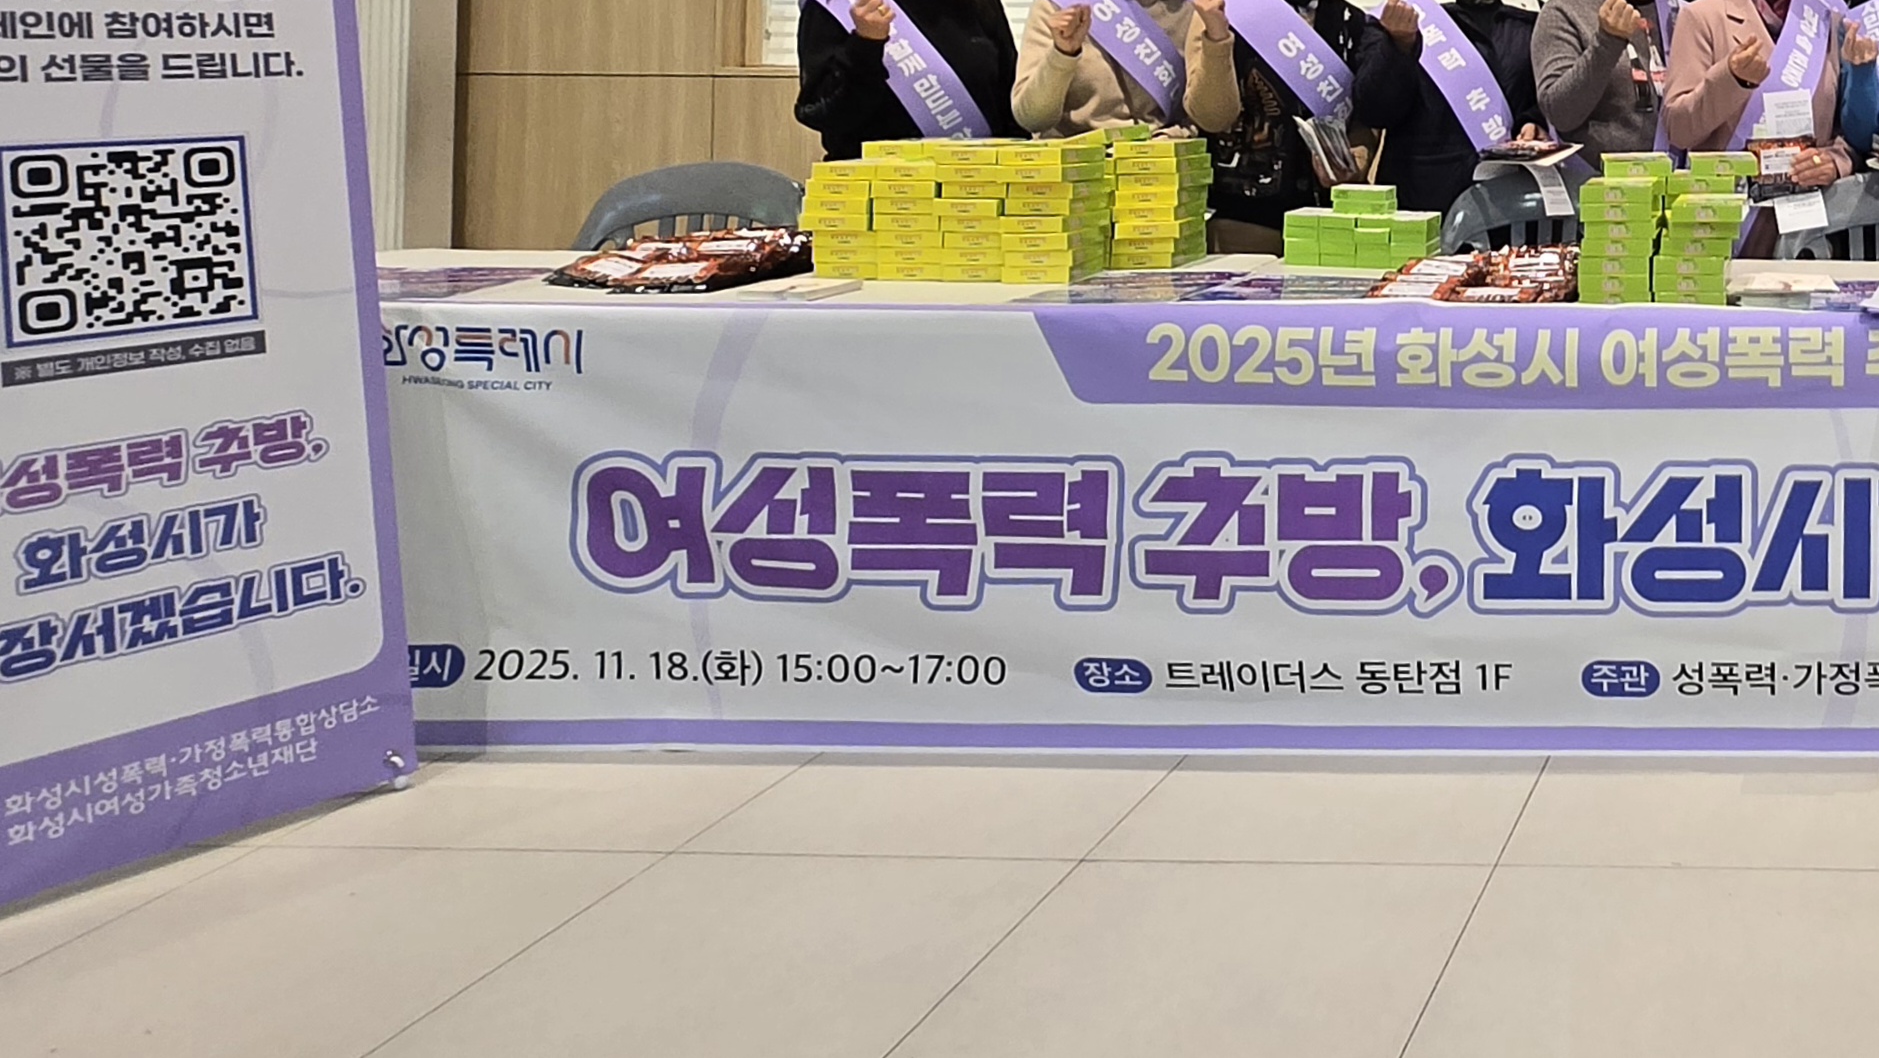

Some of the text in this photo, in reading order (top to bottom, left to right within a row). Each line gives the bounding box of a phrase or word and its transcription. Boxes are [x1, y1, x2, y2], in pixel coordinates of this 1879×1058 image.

[104, 11, 275, 40] 참여하시면
[40, 52, 151, 83] 선물을
[161, 51, 304, 80] 드립니다.
[913, 73, 963, 130] 만드는
[1465, 86, 1508, 141] 추방
[35, 360, 74, 378] 별도
[76, 351, 147, 373] 개인정보
[148, 346, 187, 366] 작성,
[187, 341, 222, 359] 수집
[223, 336, 256, 355] 없음
[1144, 322, 1376, 387] 2025년
[1395, 325, 1580, 388] 화성시
[1600, 325, 1845, 388] 여성폭력
[466, 379, 520, 391] SPECIAL
[523, 380, 553, 391] CITY
[196, 414, 325, 476] 추방,
[21, 498, 262, 592] 화성시가
[582, 461, 1112, 600] 여성폭력
[1140, 461, 1451, 604] 추방,
[474, 648, 579, 683] 2025.
[595, 650, 635, 682] 11.
[649, 647, 764, 687] 18.(화)
[777, 652, 1007, 687] 15:00~17:00
[1082, 659, 1514, 696] 장소 트레이더스 동탄점 1F
[1590, 664, 1650, 693] 주관
[3, 694, 381, 818] 화성시성폭력·가정폭력통합상담소
[7, 739, 320, 846] 화성시여성가족청소년재단
